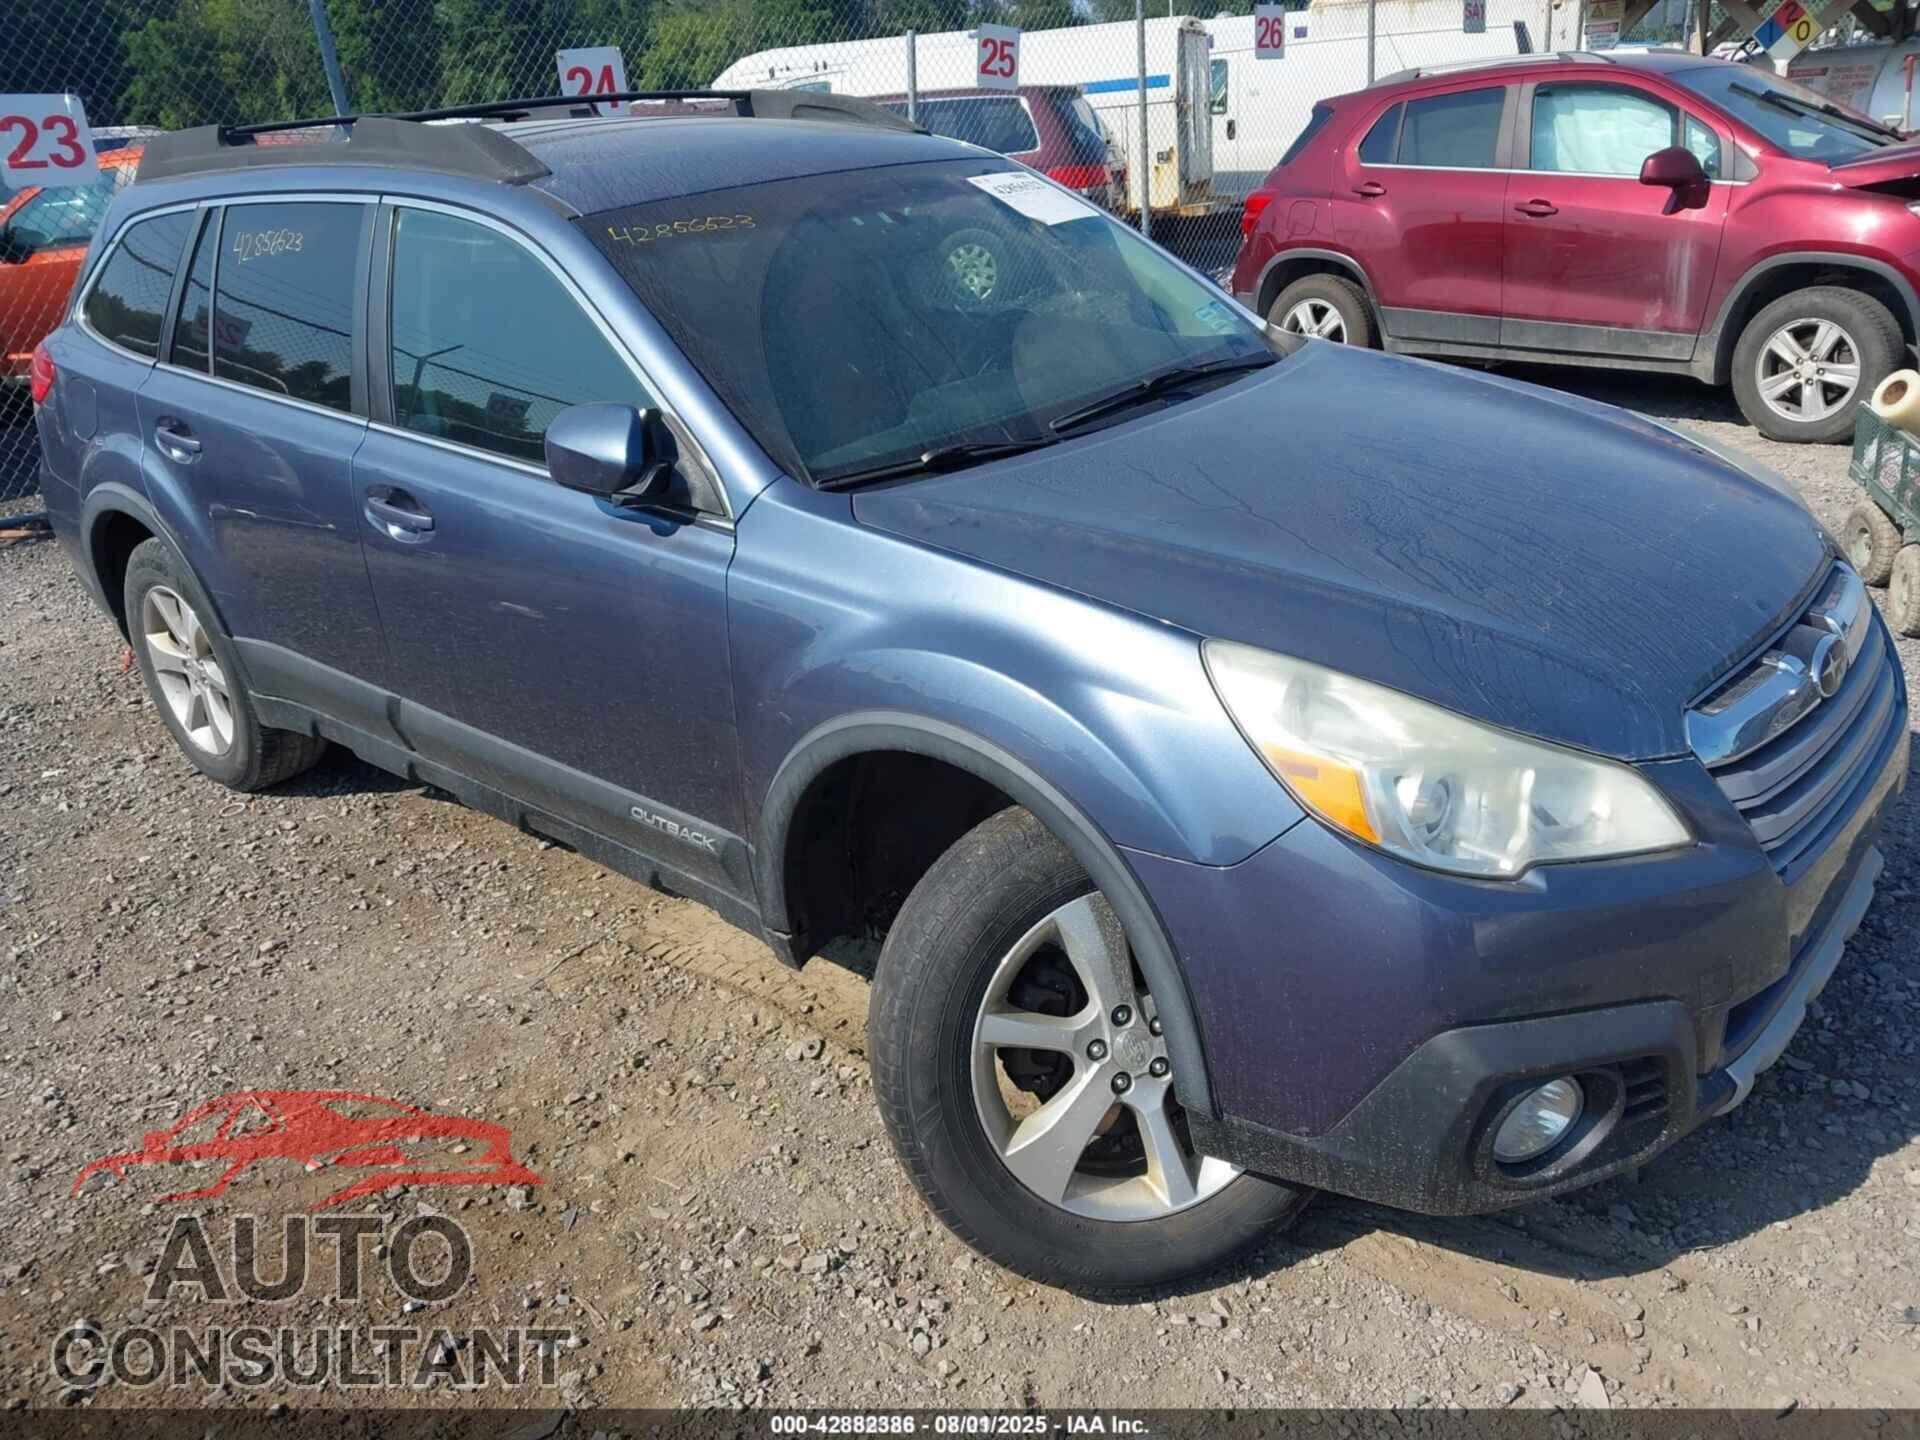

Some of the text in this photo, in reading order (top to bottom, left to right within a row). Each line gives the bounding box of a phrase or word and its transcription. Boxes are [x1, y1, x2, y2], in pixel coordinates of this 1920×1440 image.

[1257, 16, 1282, 49] 26
[1796, 20, 1810, 41] 0
[980, 37, 1015, 78] 25
[566, 64, 619, 108] 24
[0, 114, 86, 169] 23
[630, 806, 718, 856] OUTBACK
